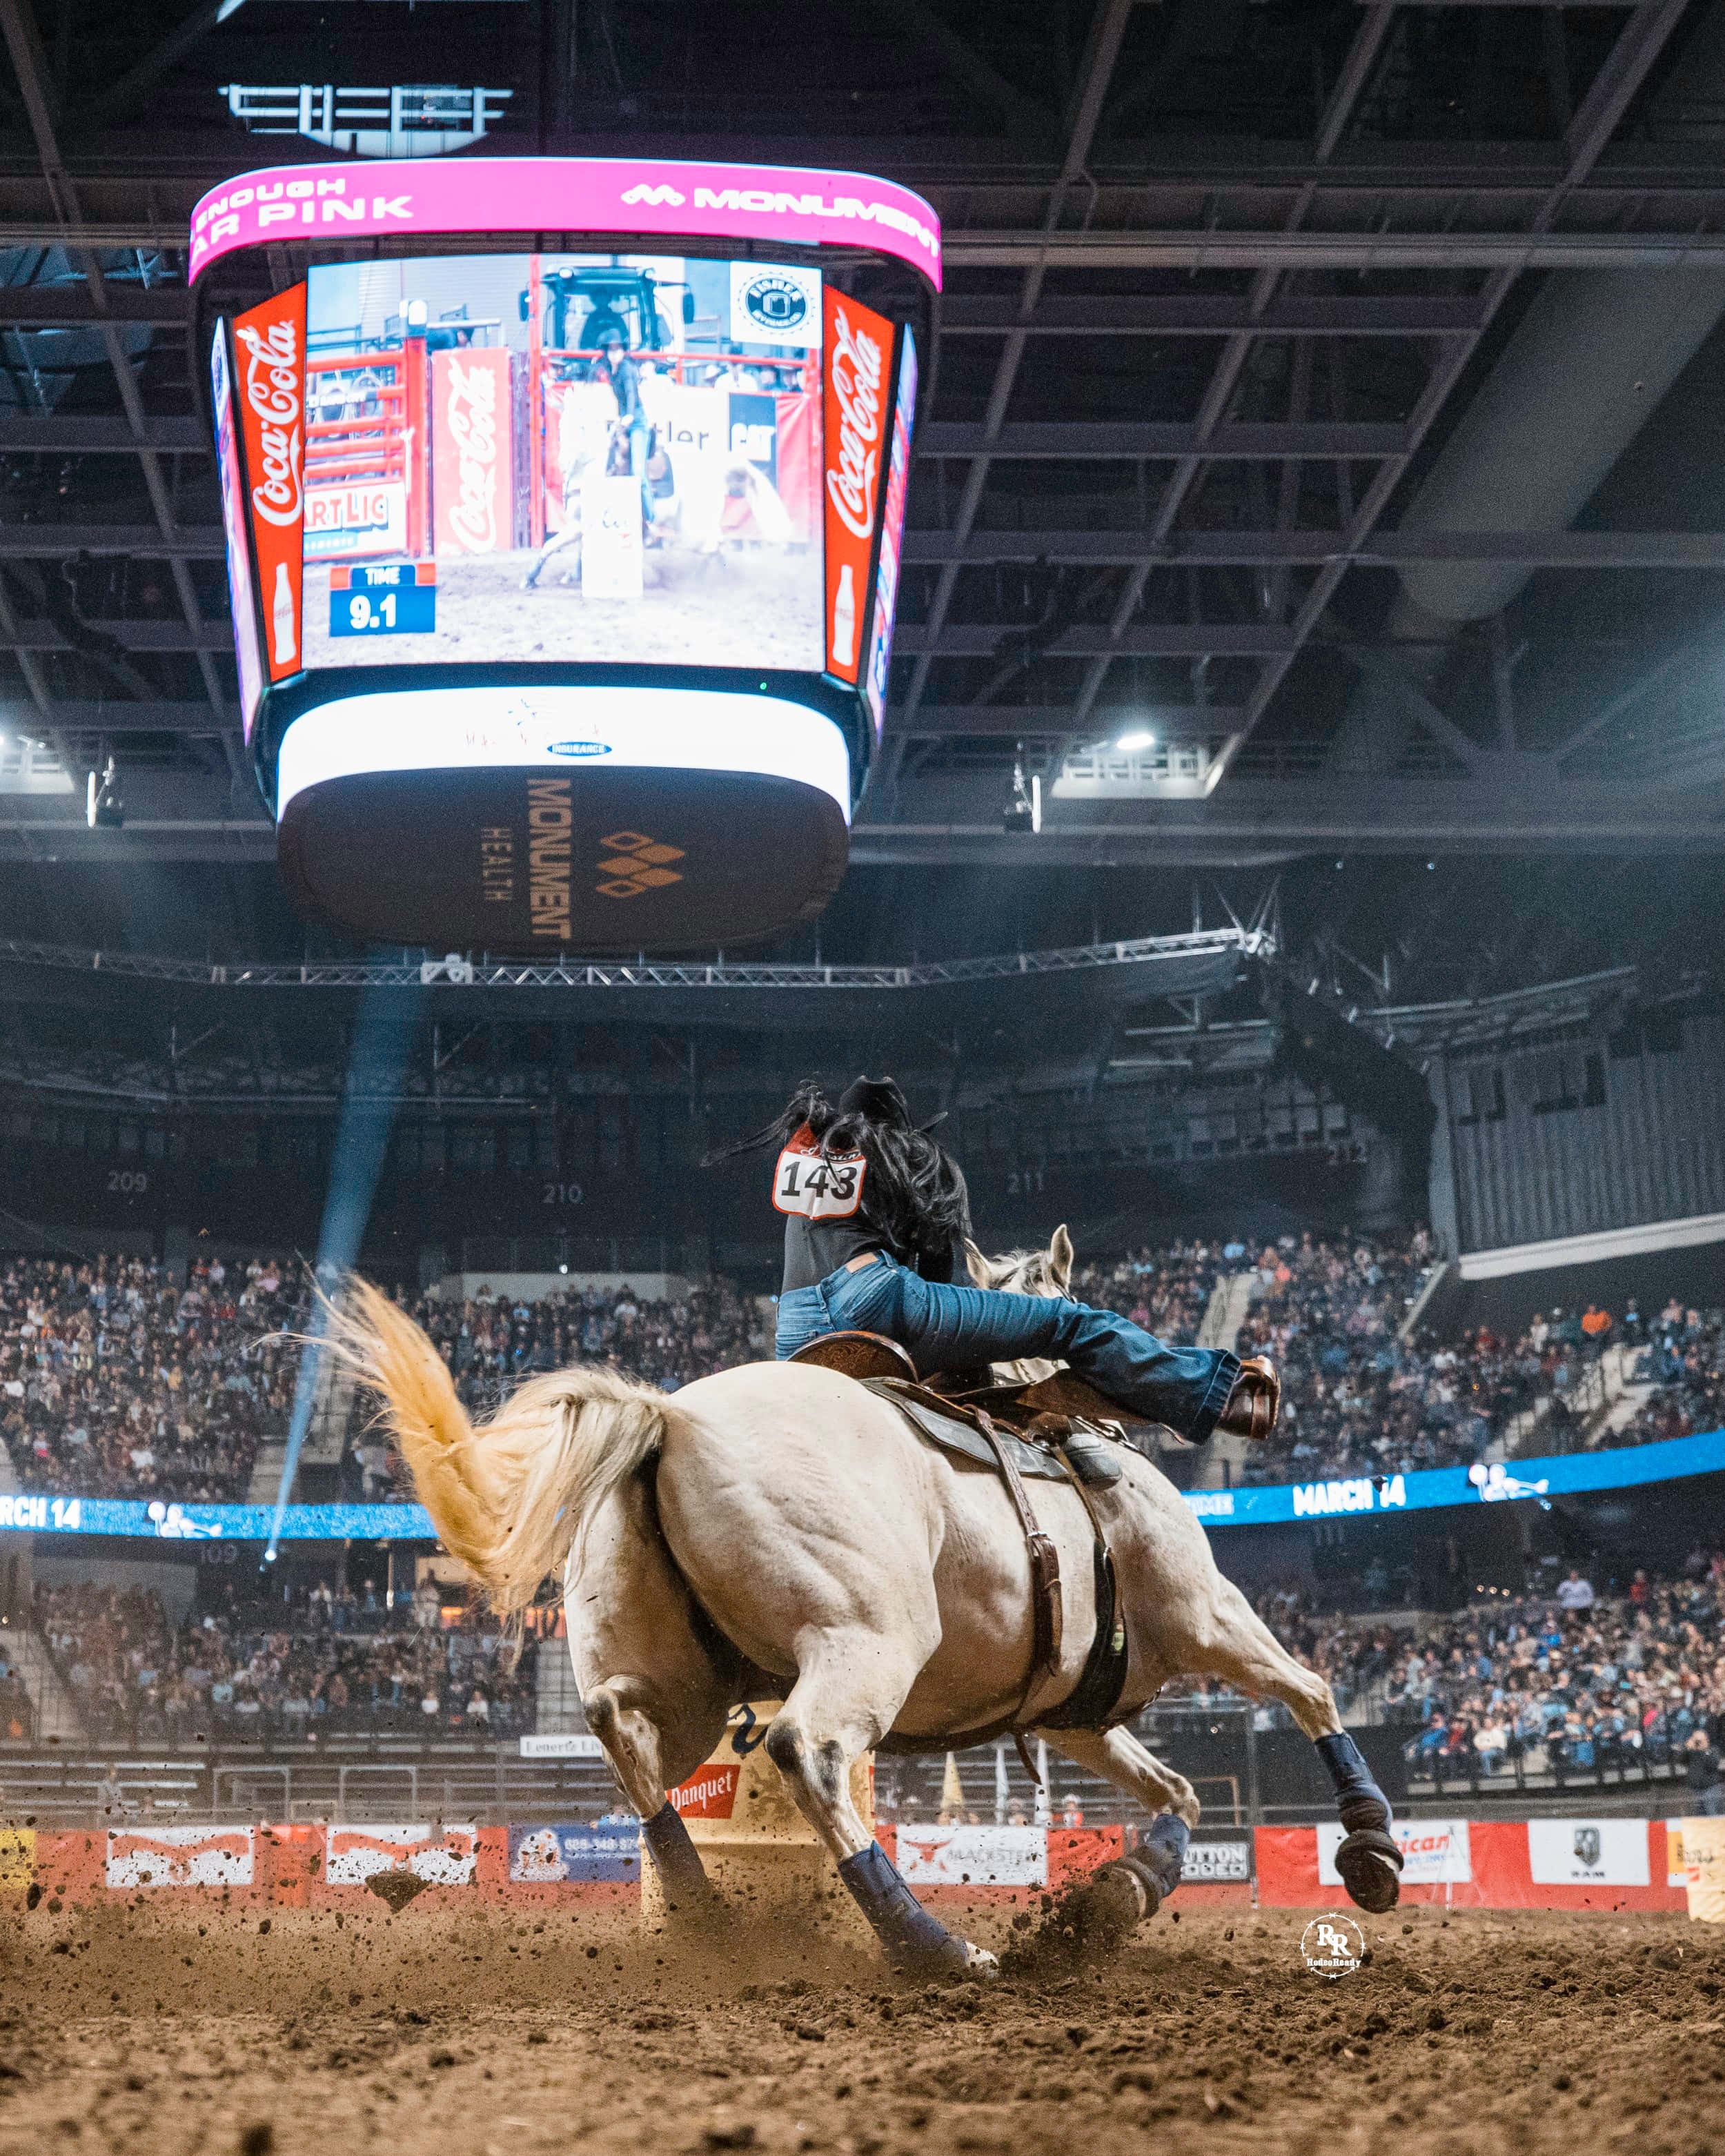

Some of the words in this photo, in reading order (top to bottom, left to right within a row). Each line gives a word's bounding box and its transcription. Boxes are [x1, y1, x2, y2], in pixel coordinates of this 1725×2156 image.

[196, 179, 346, 233] ENOUGH
[190, 214, 239, 266] AR
[259, 195, 414, 227] PINK
[365, 568, 401, 586] TIME
[349, 593, 397, 629] 9.1
[552, 744, 606, 754] INSURANCE
[481, 827, 514, 901] HEALTH
[527, 779, 573, 939] MONUMENT
[109, 1170, 147, 1192] 209
[544, 1184, 582, 1204] 210
[781, 1161, 858, 1200] 143
[1007, 1172, 1045, 1194] 211
[1292, 1478, 1374, 1516] MARCH
[1380, 1475, 1407, 1508] 14
[50, 1499, 81, 1530] 14
[671, 1770, 732, 1812] Banquet
[1183, 1847, 1244, 1864] UTTON
